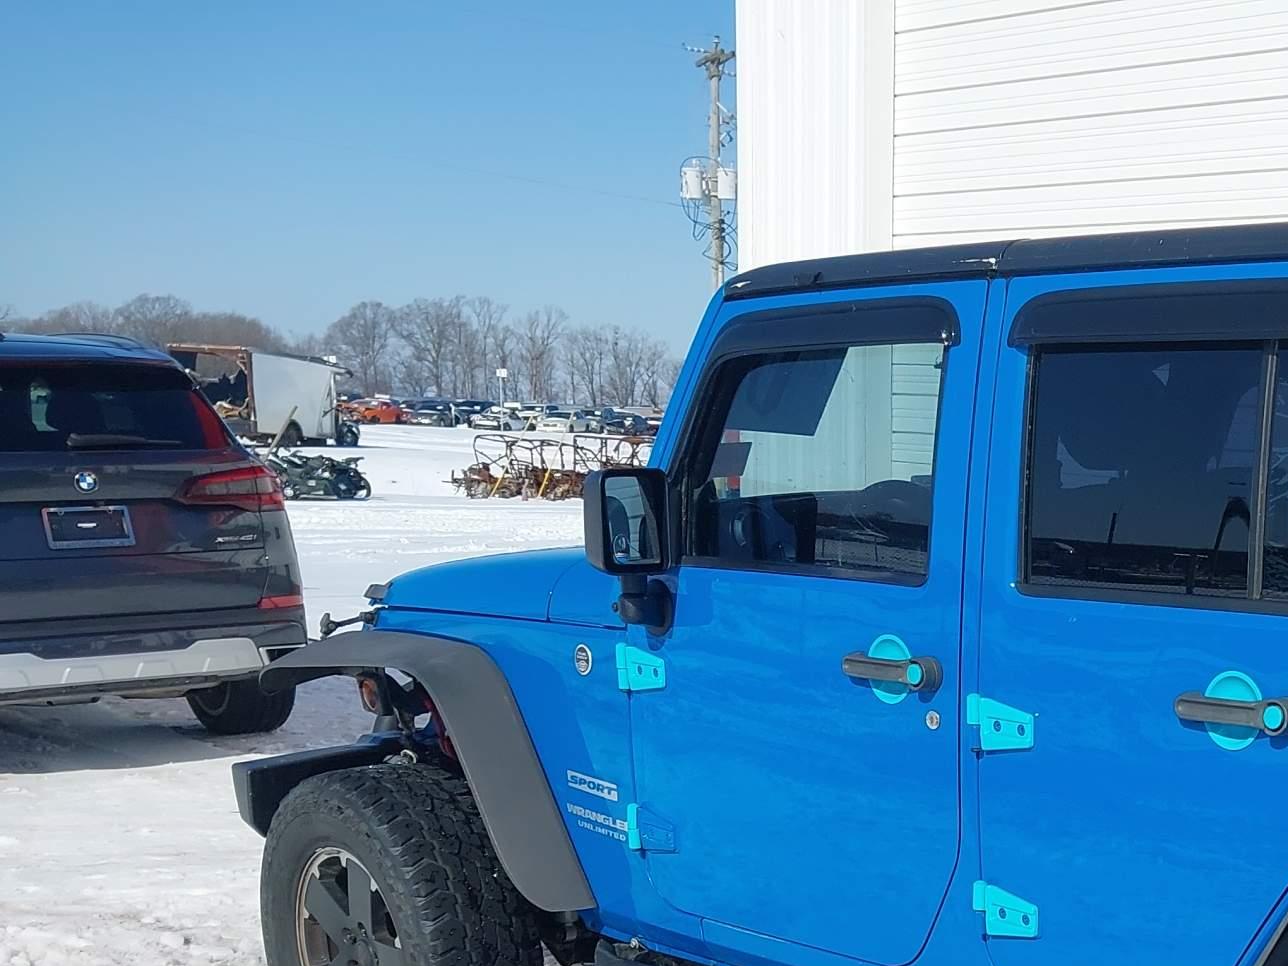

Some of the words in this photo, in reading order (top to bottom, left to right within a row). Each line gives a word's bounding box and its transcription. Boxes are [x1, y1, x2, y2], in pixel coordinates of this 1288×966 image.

[568, 774, 617, 797] SPORT
[567, 803, 628, 832] WRANGLE
[577, 820, 627, 842] UNLIMITED
